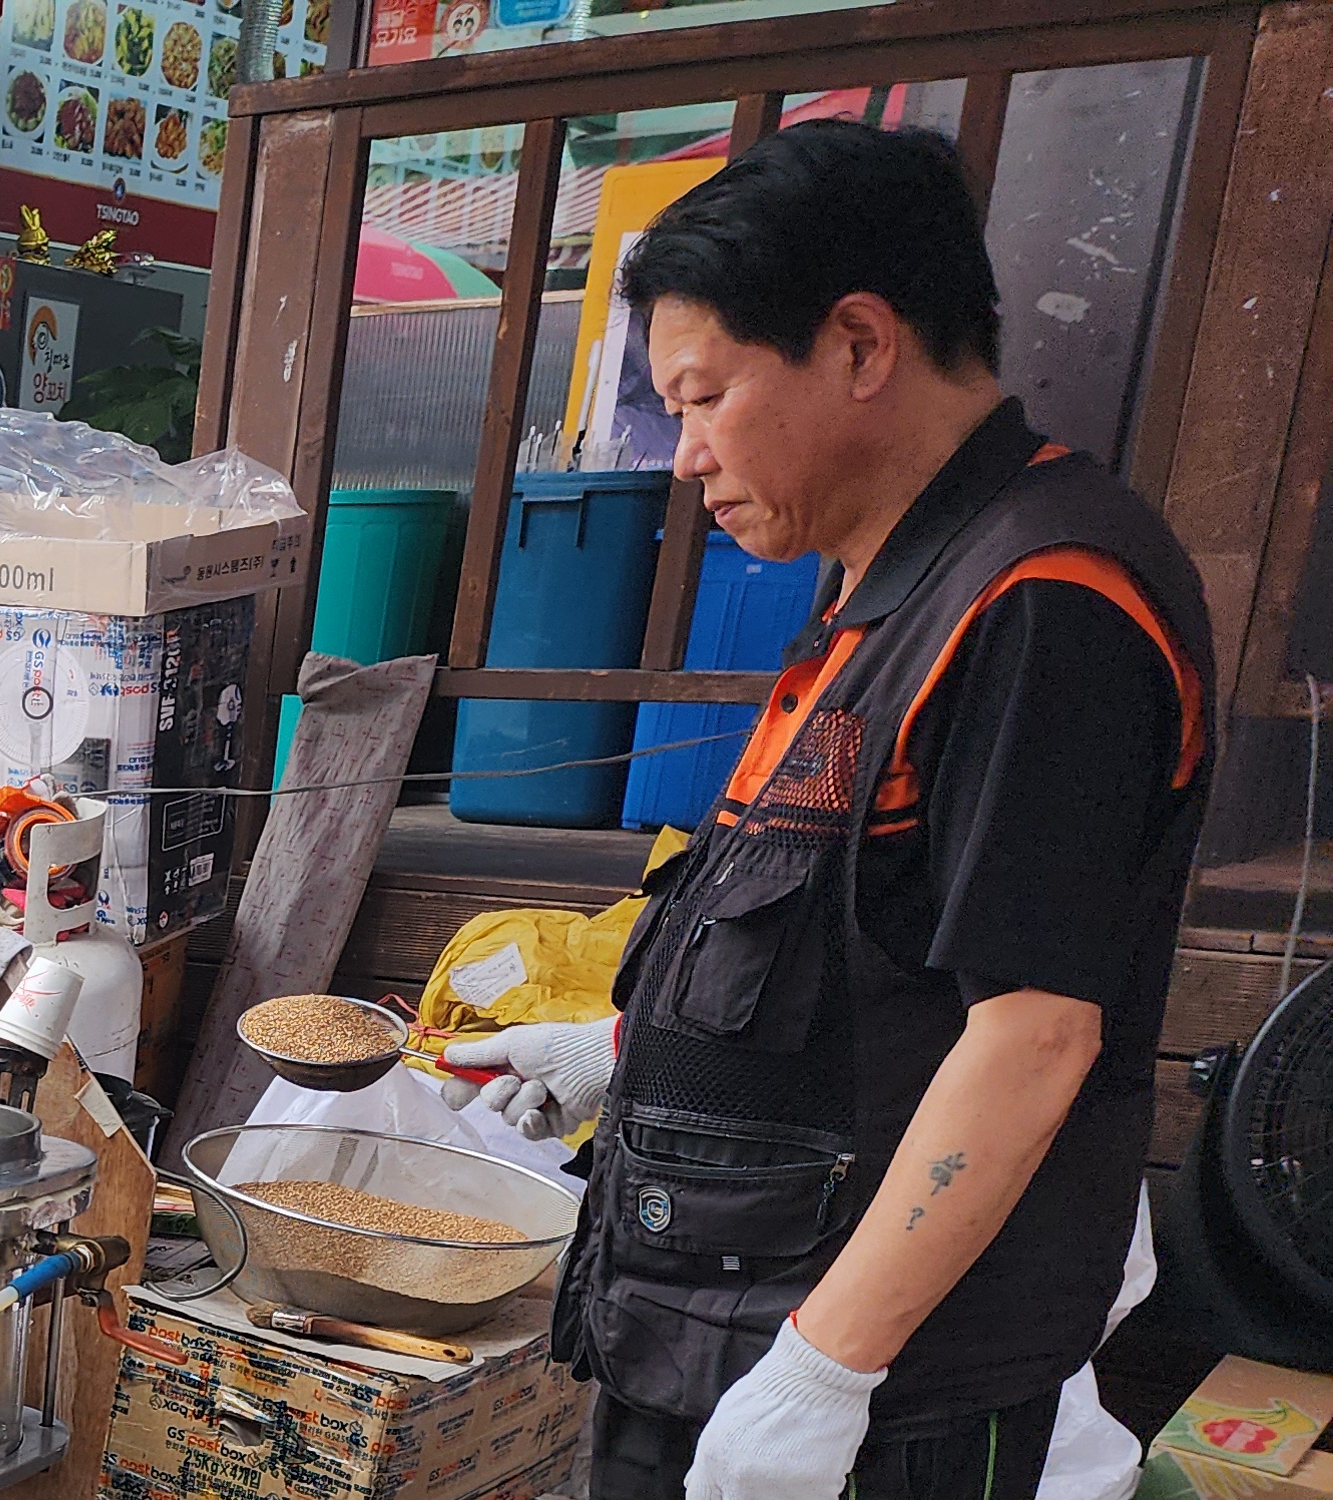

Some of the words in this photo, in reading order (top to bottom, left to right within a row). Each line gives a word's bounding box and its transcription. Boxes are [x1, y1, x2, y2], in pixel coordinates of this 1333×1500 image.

[375, 27, 418, 48] 요기요
[96, 204, 139, 225] TSINGTAO
[33, 373, 68, 403] 양꼬치
[167, 1426, 186, 1442] GS
[187, 1434, 249, 1465] postbox
